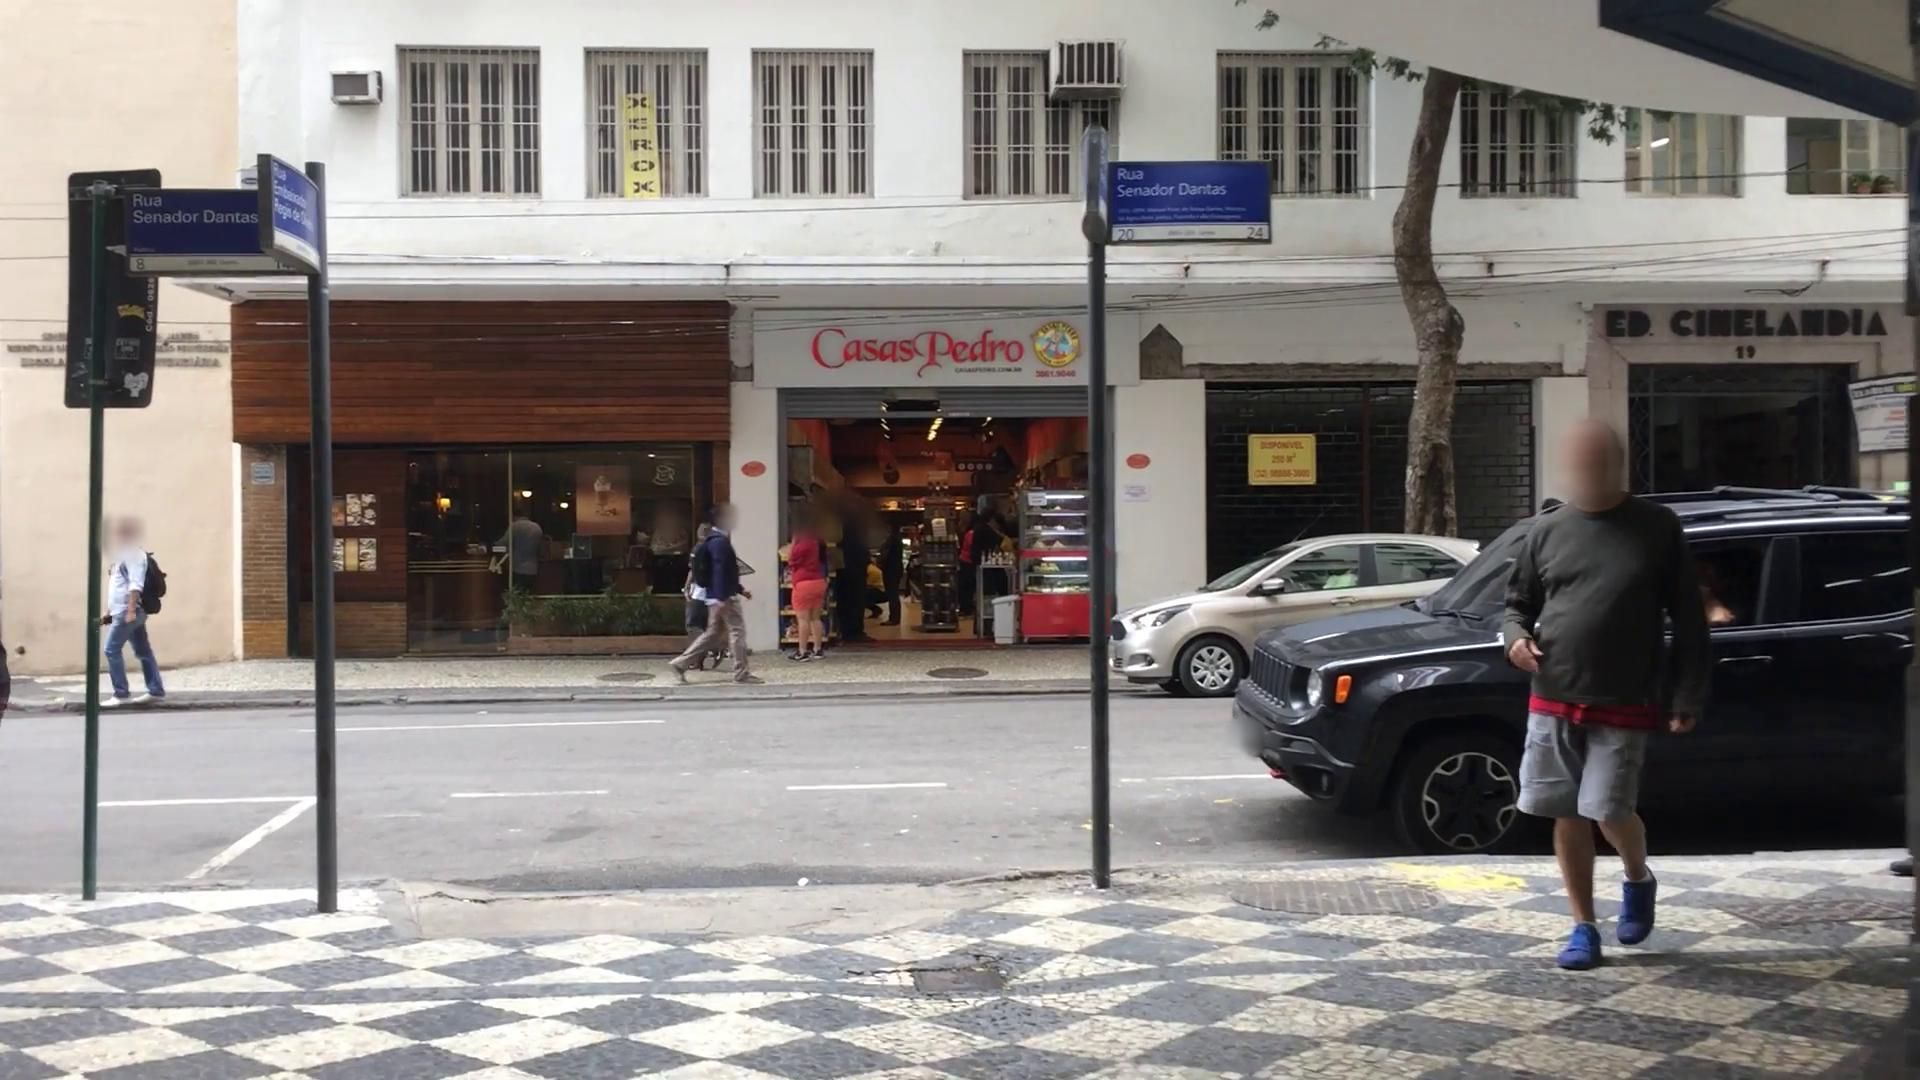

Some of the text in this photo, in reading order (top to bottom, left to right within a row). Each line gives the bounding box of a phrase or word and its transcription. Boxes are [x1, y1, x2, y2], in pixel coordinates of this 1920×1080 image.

[627, 96, 655, 194] XEROX
[1117, 168, 1144, 180] Rua
[1117, 183, 1227, 197] Senador Dantas
[132, 194, 162, 207] Rua
[133, 209, 258, 223] Senador Dantas
[1118, 229, 1134, 240] 20
[1248, 227, 1264, 239] 24
[136, 258, 145, 270] 8
[1606, 309, 1888, 337] ED. CINELANDIA
[811, 328, 914, 368] Casas
[912, 330, 1024, 378] Pedro
[1735, 345, 1756, 360] 19
